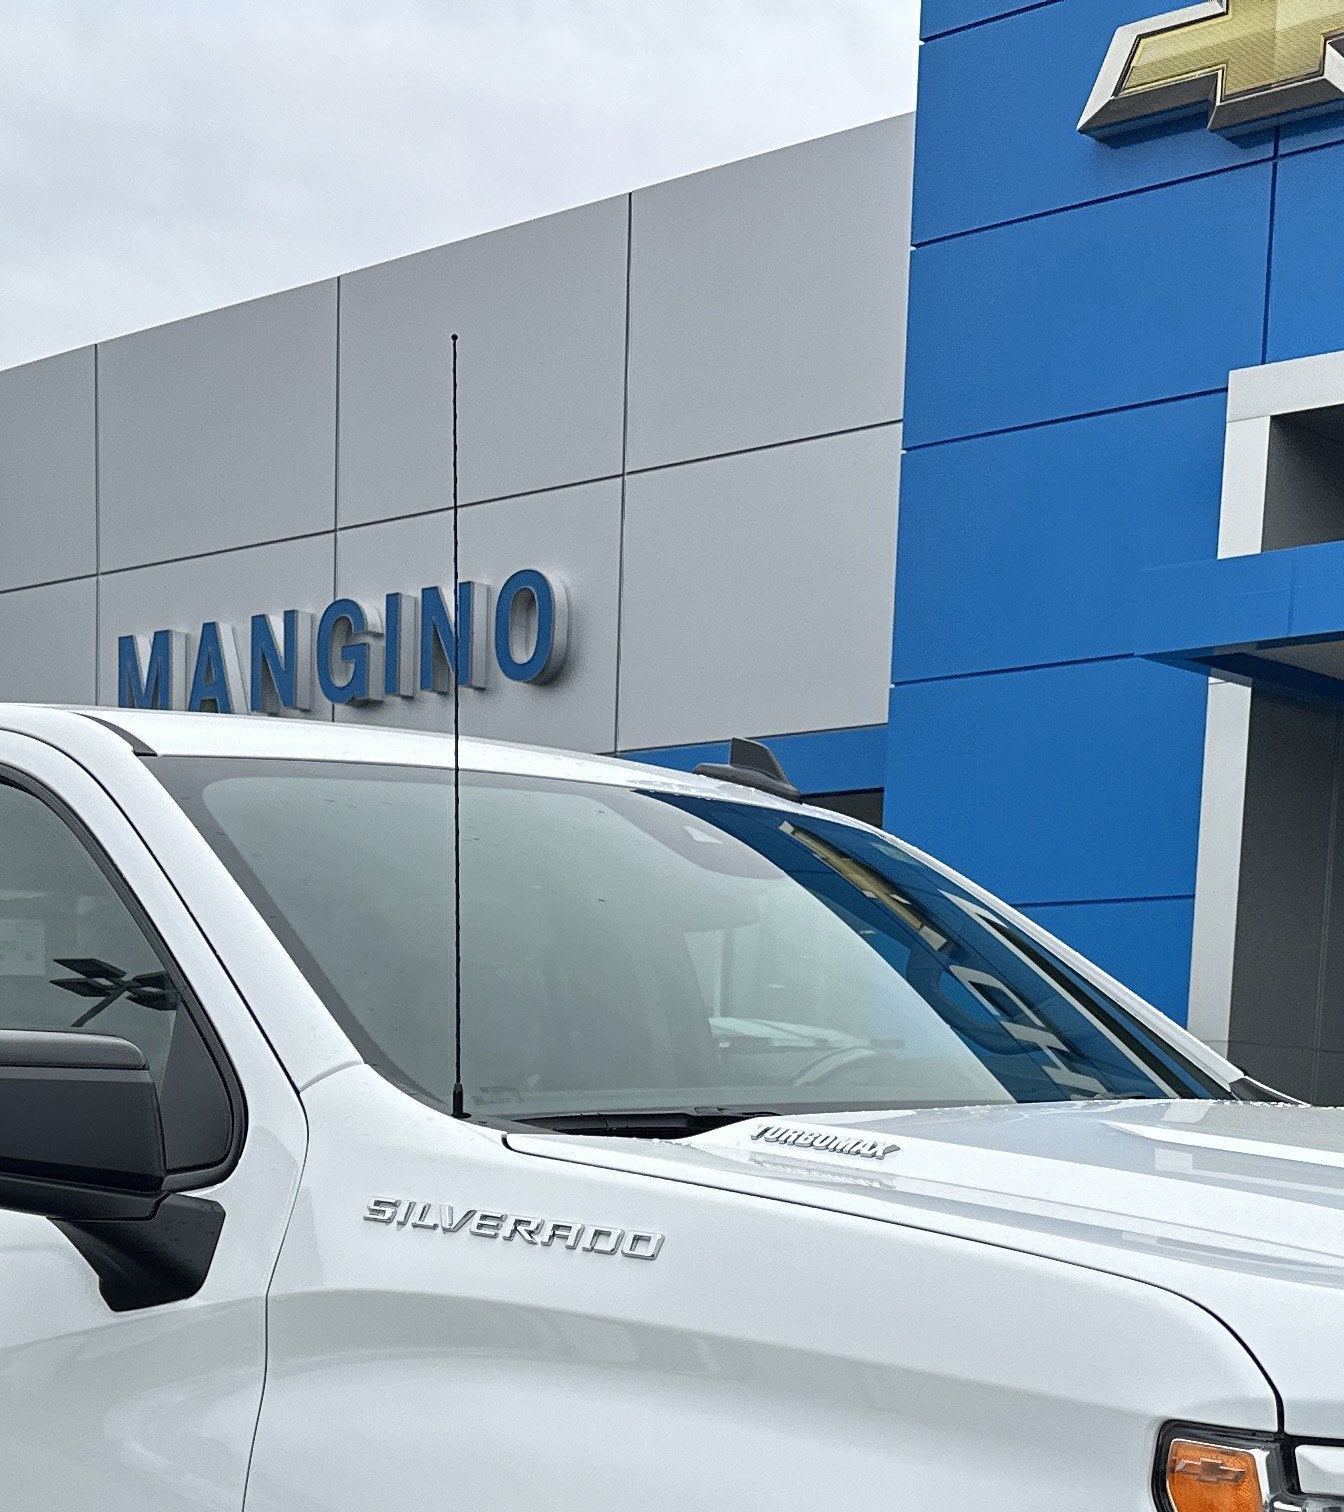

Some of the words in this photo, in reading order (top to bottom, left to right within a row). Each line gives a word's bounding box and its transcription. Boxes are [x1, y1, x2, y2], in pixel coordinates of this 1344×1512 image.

[118, 568, 568, 712] MANGINO
[750, 1124, 902, 1160] TURBOMAX
[362, 1197, 666, 1260] SILVERADO
